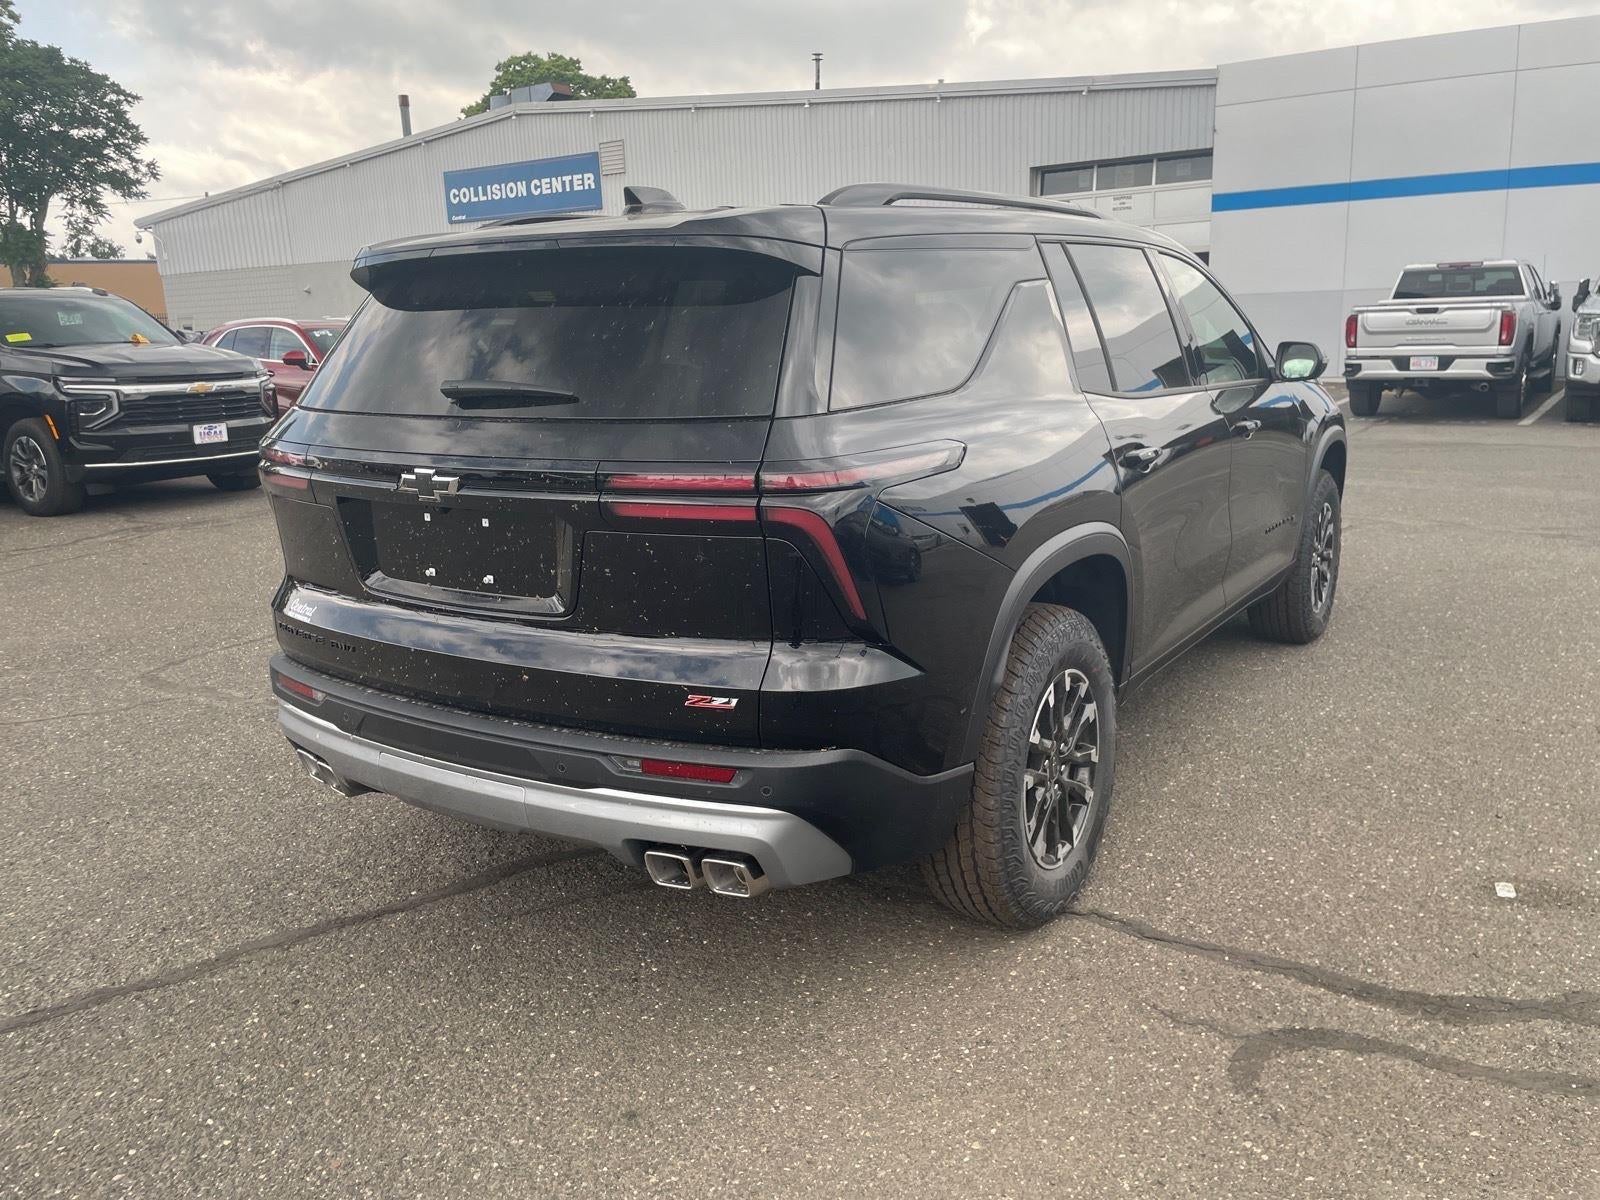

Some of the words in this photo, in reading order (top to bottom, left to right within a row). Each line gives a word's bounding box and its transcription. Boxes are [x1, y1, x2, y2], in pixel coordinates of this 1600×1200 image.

[450, 181, 527, 204] COLLISION
[530, 172, 596, 196] CENTER
[289, 598, 318, 617] Central
[685, 695, 739, 710] Z71
